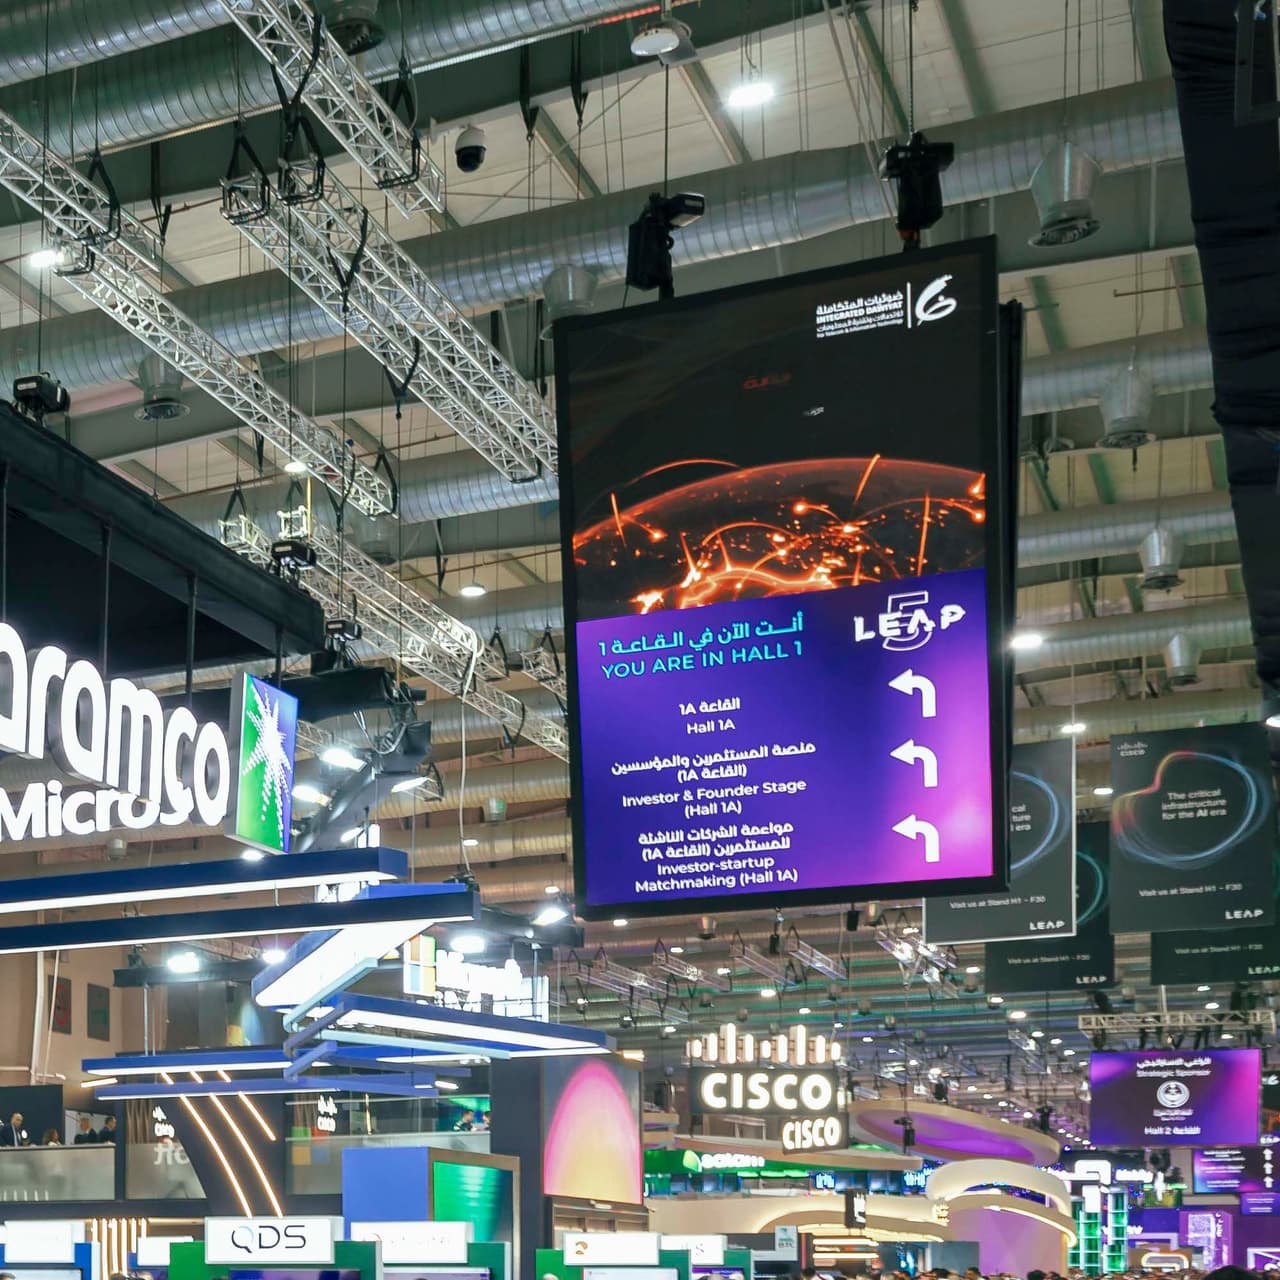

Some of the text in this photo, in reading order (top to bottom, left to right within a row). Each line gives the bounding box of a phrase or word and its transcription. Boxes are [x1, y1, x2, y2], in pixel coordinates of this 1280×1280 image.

[599, 611, 804, 656] أنت الآن في القاعة 1
[853, 604, 966, 642] LEAP
[601, 640, 803, 680] YOU ARE IN HALL 1
[679, 697, 741, 716] القاعة 1A
[686, 718, 736, 735] Hall 1A
[611, 741, 817, 776] منصة المستثمرين والمؤسسين
[622, 779, 807, 808] Investor & Founder Stage
[684, 799, 743, 820] (Hall 1A)
[1161, 799, 1227, 810] infrastructure
[687, 824, 738, 842] الشركات
[713, 836, 791, 857] للمستثمرين
[657, 855, 775, 876] Investor-startup
[635, 868, 799, 893] Matchmaking (Hall 1A)
[1225, 909, 1264, 919] LEAP
[1029, 920, 1065, 931] LEAP
[1076, 976, 1107, 984] LEAP
[701, 1073, 833, 1110] CISCO
[782, 1116, 840, 1150] CISCO
[230, 1223, 307, 1254] QDS
